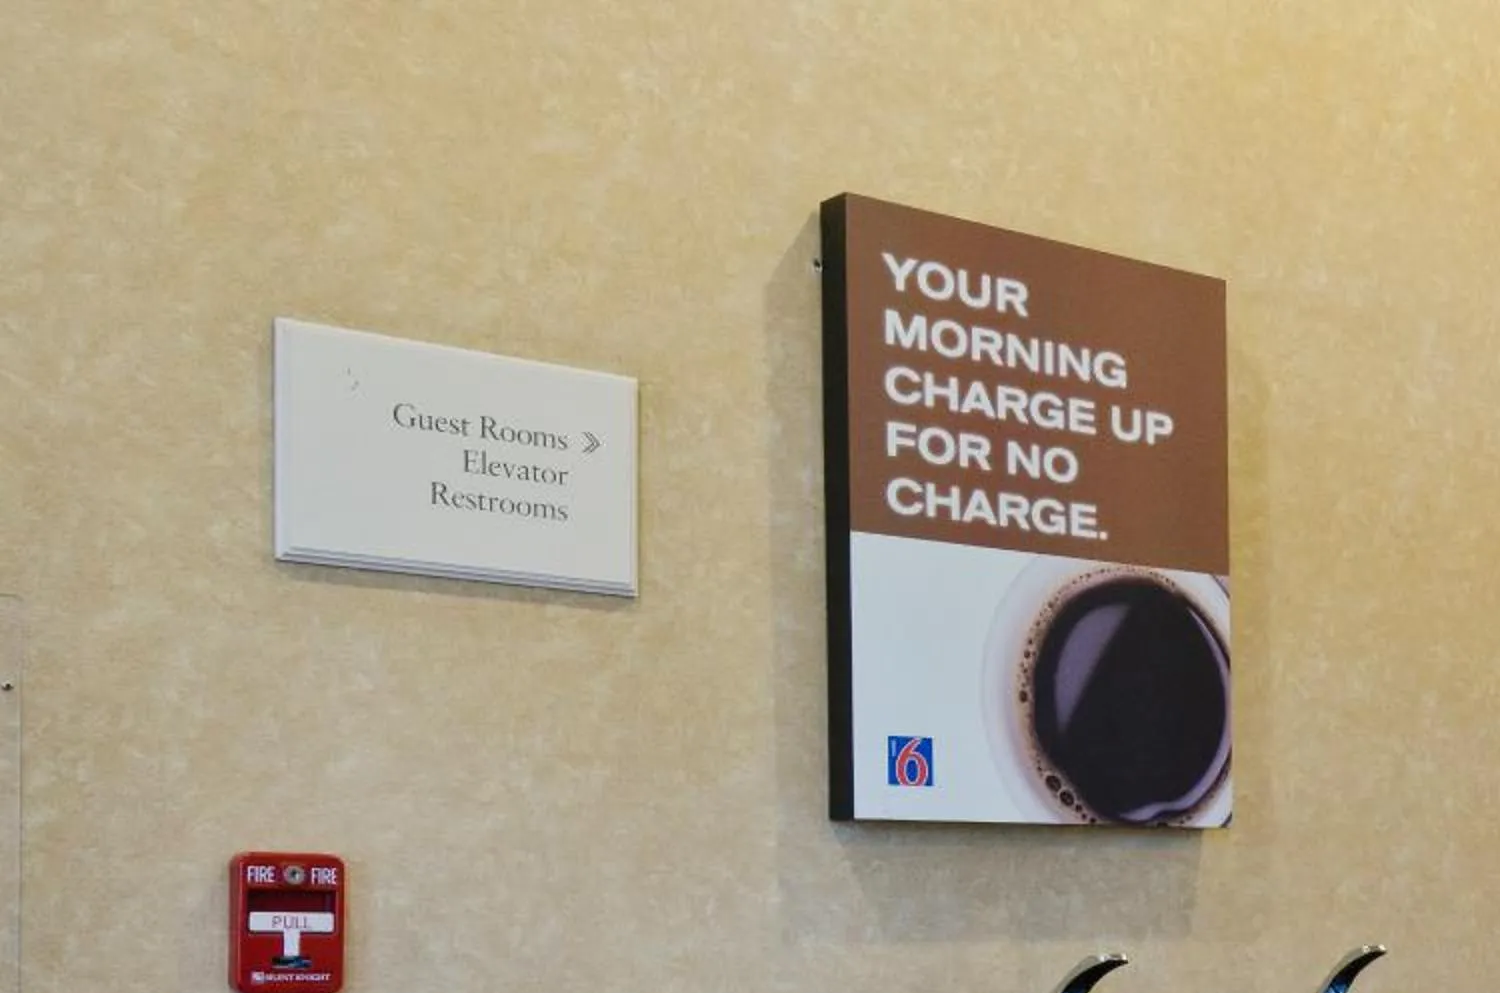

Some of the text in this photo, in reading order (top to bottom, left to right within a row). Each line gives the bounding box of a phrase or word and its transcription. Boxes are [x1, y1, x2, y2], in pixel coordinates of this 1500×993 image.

[882, 251, 1029, 318] YOUR
[883, 308, 1128, 389] MORNING
[392, 402, 570, 451] Guest Rooms
[884, 365, 1174, 445] CHARGE UP
[462, 449, 570, 487] Elevator
[885, 420, 1079, 484] FOR NO
[429, 480, 569, 523] Restrooms
[885, 477, 1110, 541] CHARGE.
[895, 736, 929, 788] 6
[246, 865, 276, 883] FIRE
[310, 867, 337, 885] FIRE
[271, 915, 309, 929] PULL
